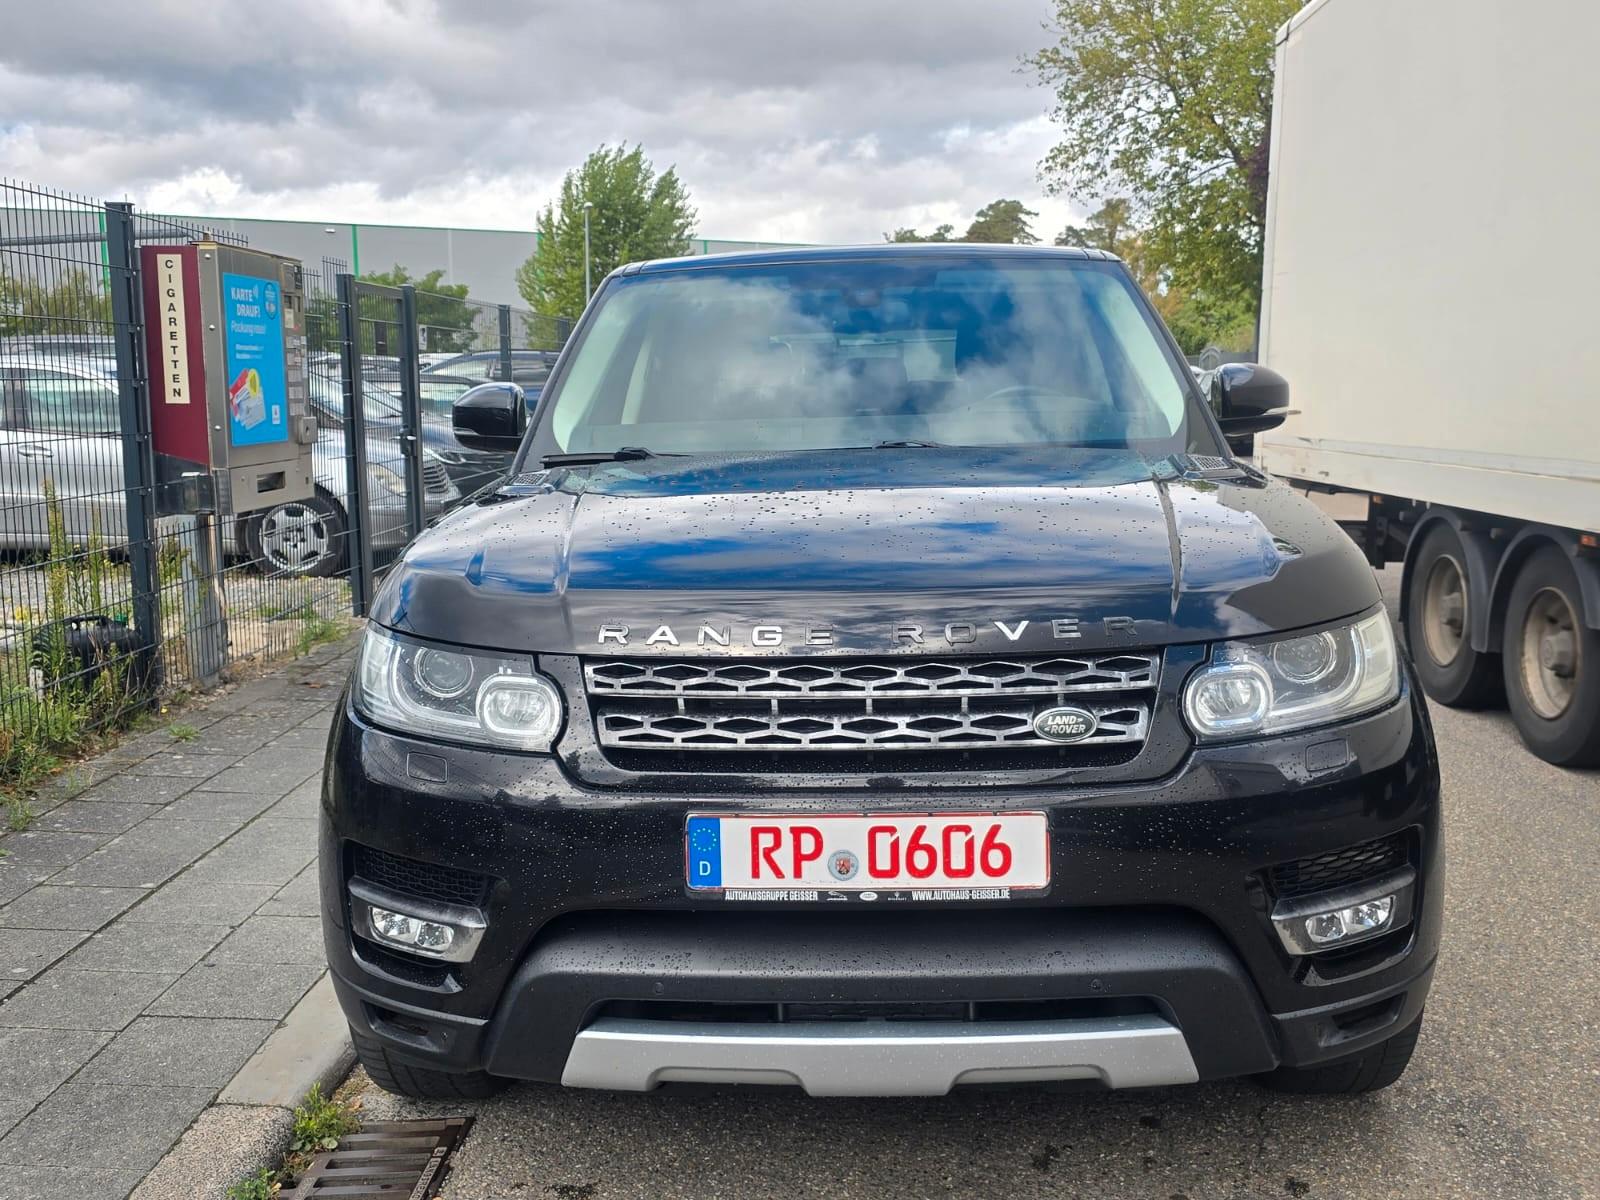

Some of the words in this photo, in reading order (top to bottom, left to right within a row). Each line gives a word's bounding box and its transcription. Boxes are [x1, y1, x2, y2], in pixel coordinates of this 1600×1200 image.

[231, 286, 253, 302] KARTE
[164, 258, 182, 399] CIGARETTEN
[597, 623, 836, 647] RANGE
[892, 615, 1138, 645] ROVER
[1047, 715, 1077, 725] LAND
[1050, 724, 1086, 734] ROVER
[750, 826, 824, 879] RP
[867, 824, 1013, 879] 0606
[698, 861, 711, 876] D
[725, 890, 788, 901] AUTOHAUSGRUPPE
[789, 890, 818, 901] GEISSER
[911, 888, 1010, 901] WWW.AUTOHAUS-GEISSER.DE
